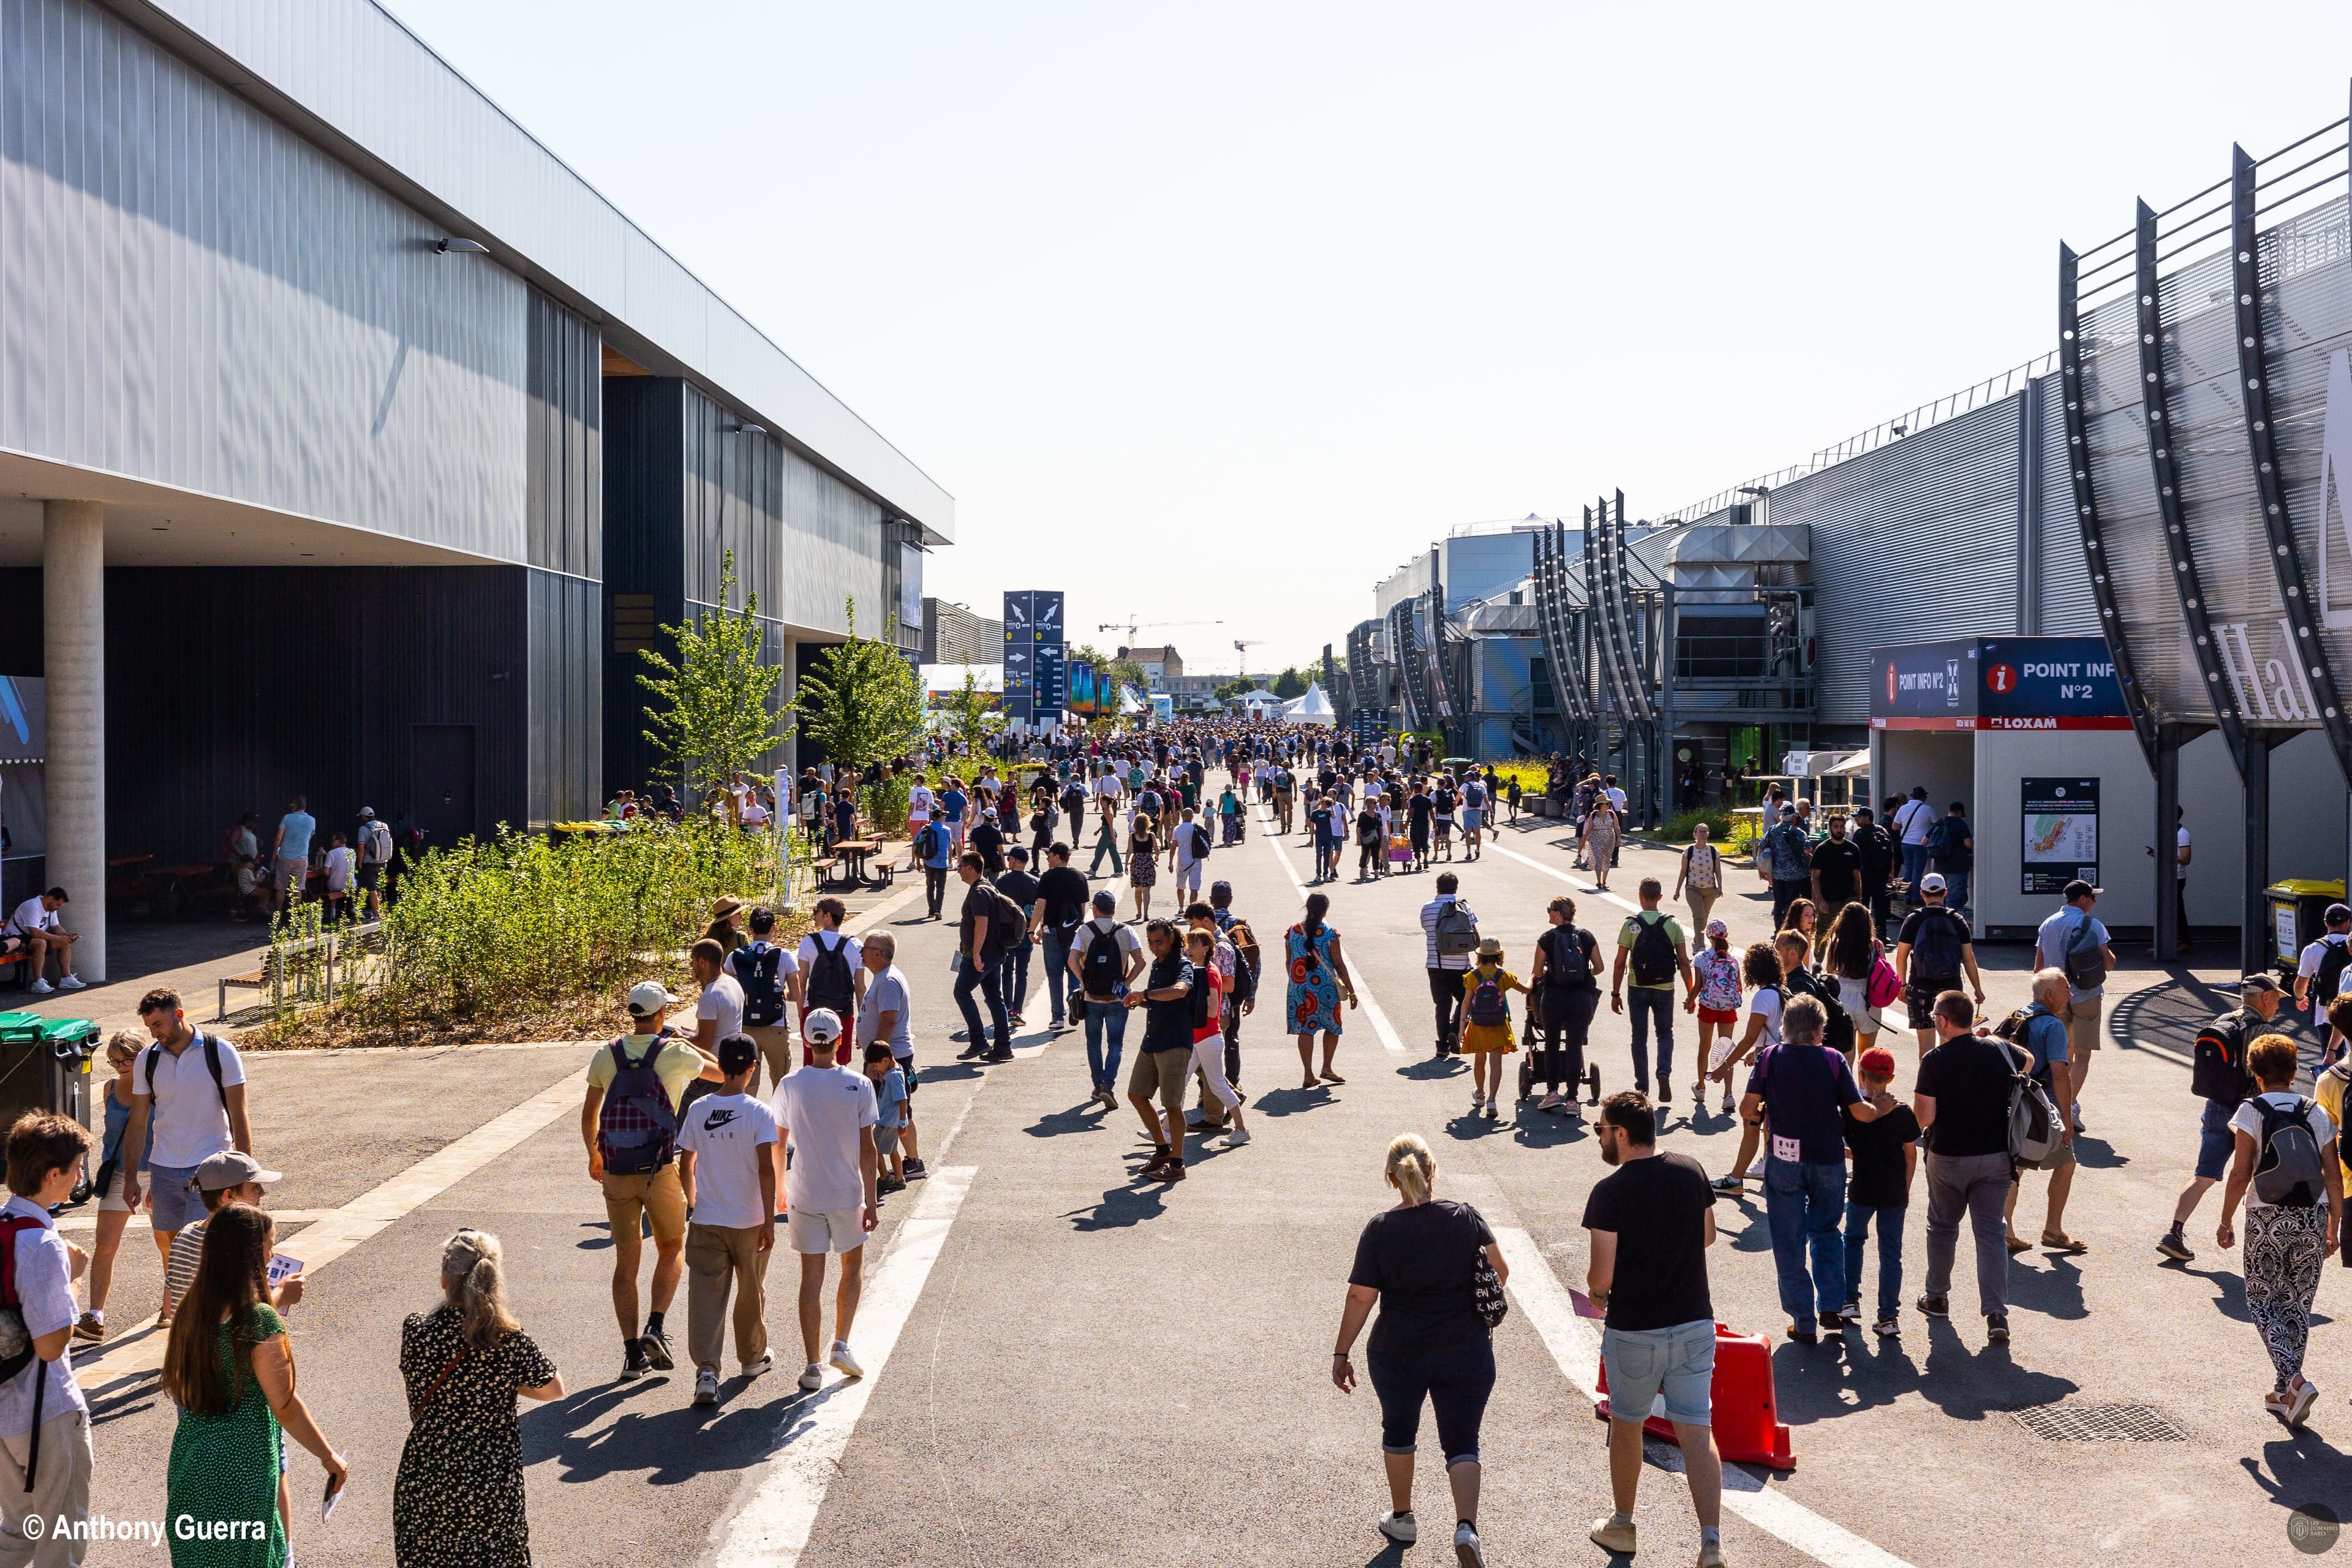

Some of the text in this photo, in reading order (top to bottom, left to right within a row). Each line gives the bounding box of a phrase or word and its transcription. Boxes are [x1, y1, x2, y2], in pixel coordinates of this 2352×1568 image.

[2024, 663, 2115, 677] POINT INF
[2210, 617, 2320, 722] Hal
[1899, 673, 1943, 690] POINT INFO N°2
[2061, 685, 2092, 698] N°2
[2004, 718, 2057, 728] LOXAM
[709, 1110, 734, 1121] NIKE
